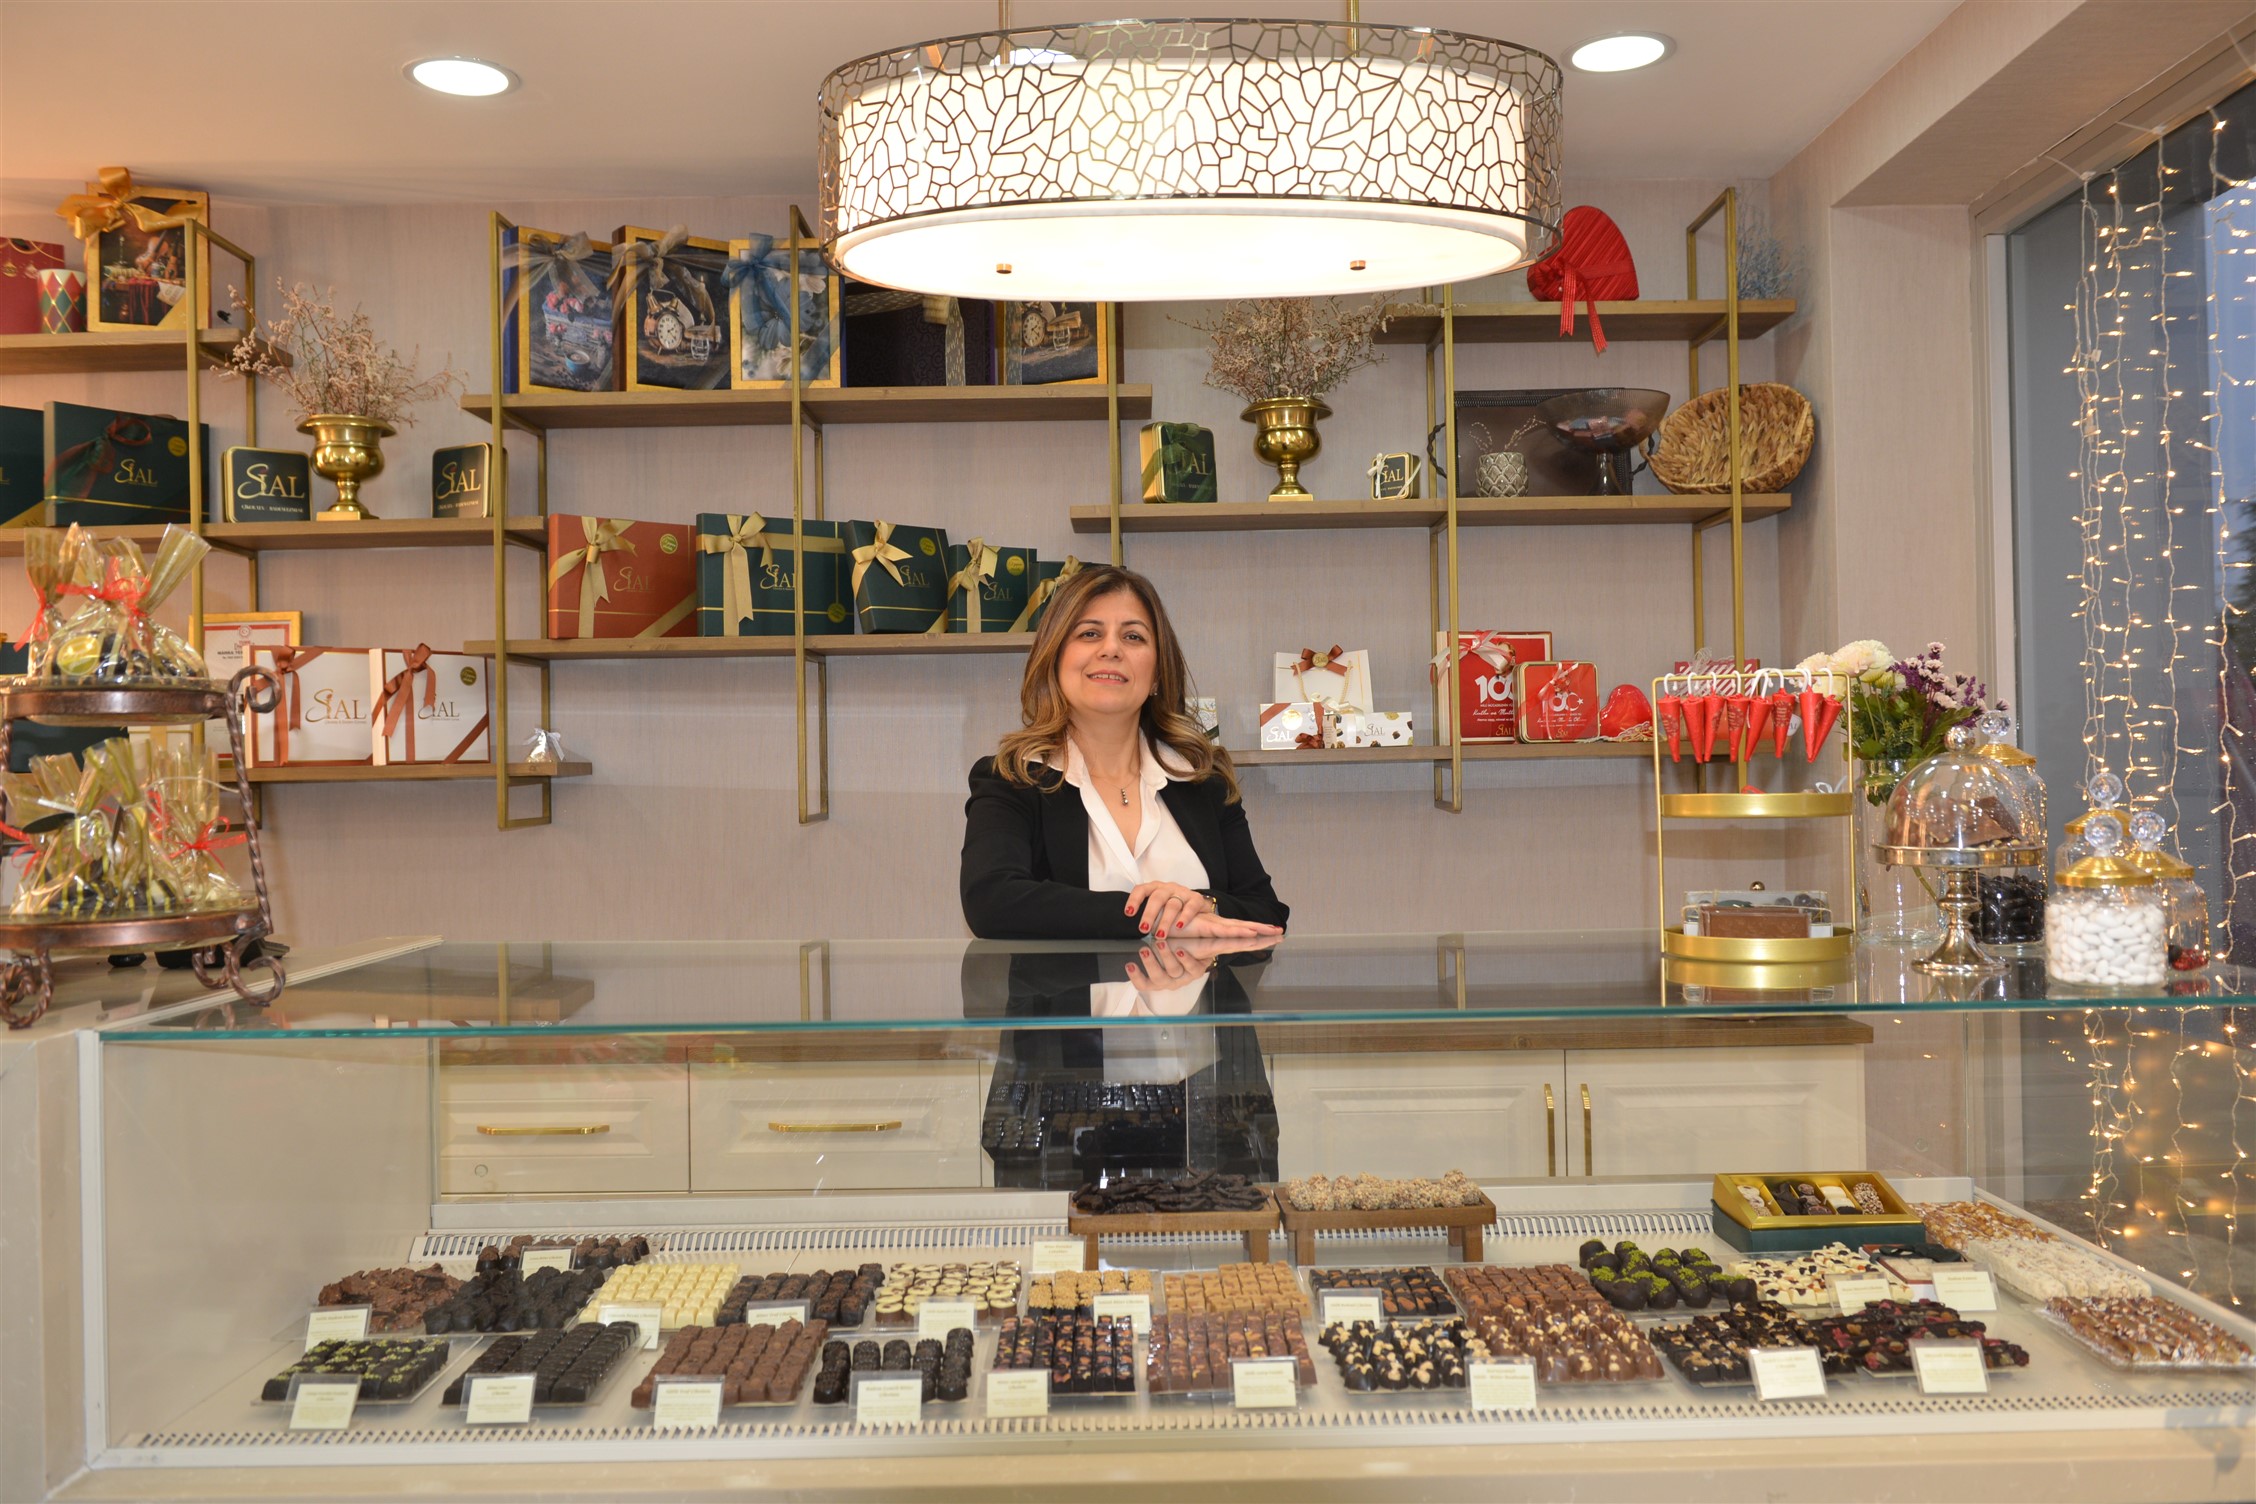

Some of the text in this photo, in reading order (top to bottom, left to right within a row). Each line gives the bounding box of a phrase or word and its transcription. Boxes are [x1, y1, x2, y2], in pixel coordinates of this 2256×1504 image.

[237, 463, 305, 499] SIAL
[436, 461, 481, 499] SIAL
[305, 688, 367, 723] SIAL
